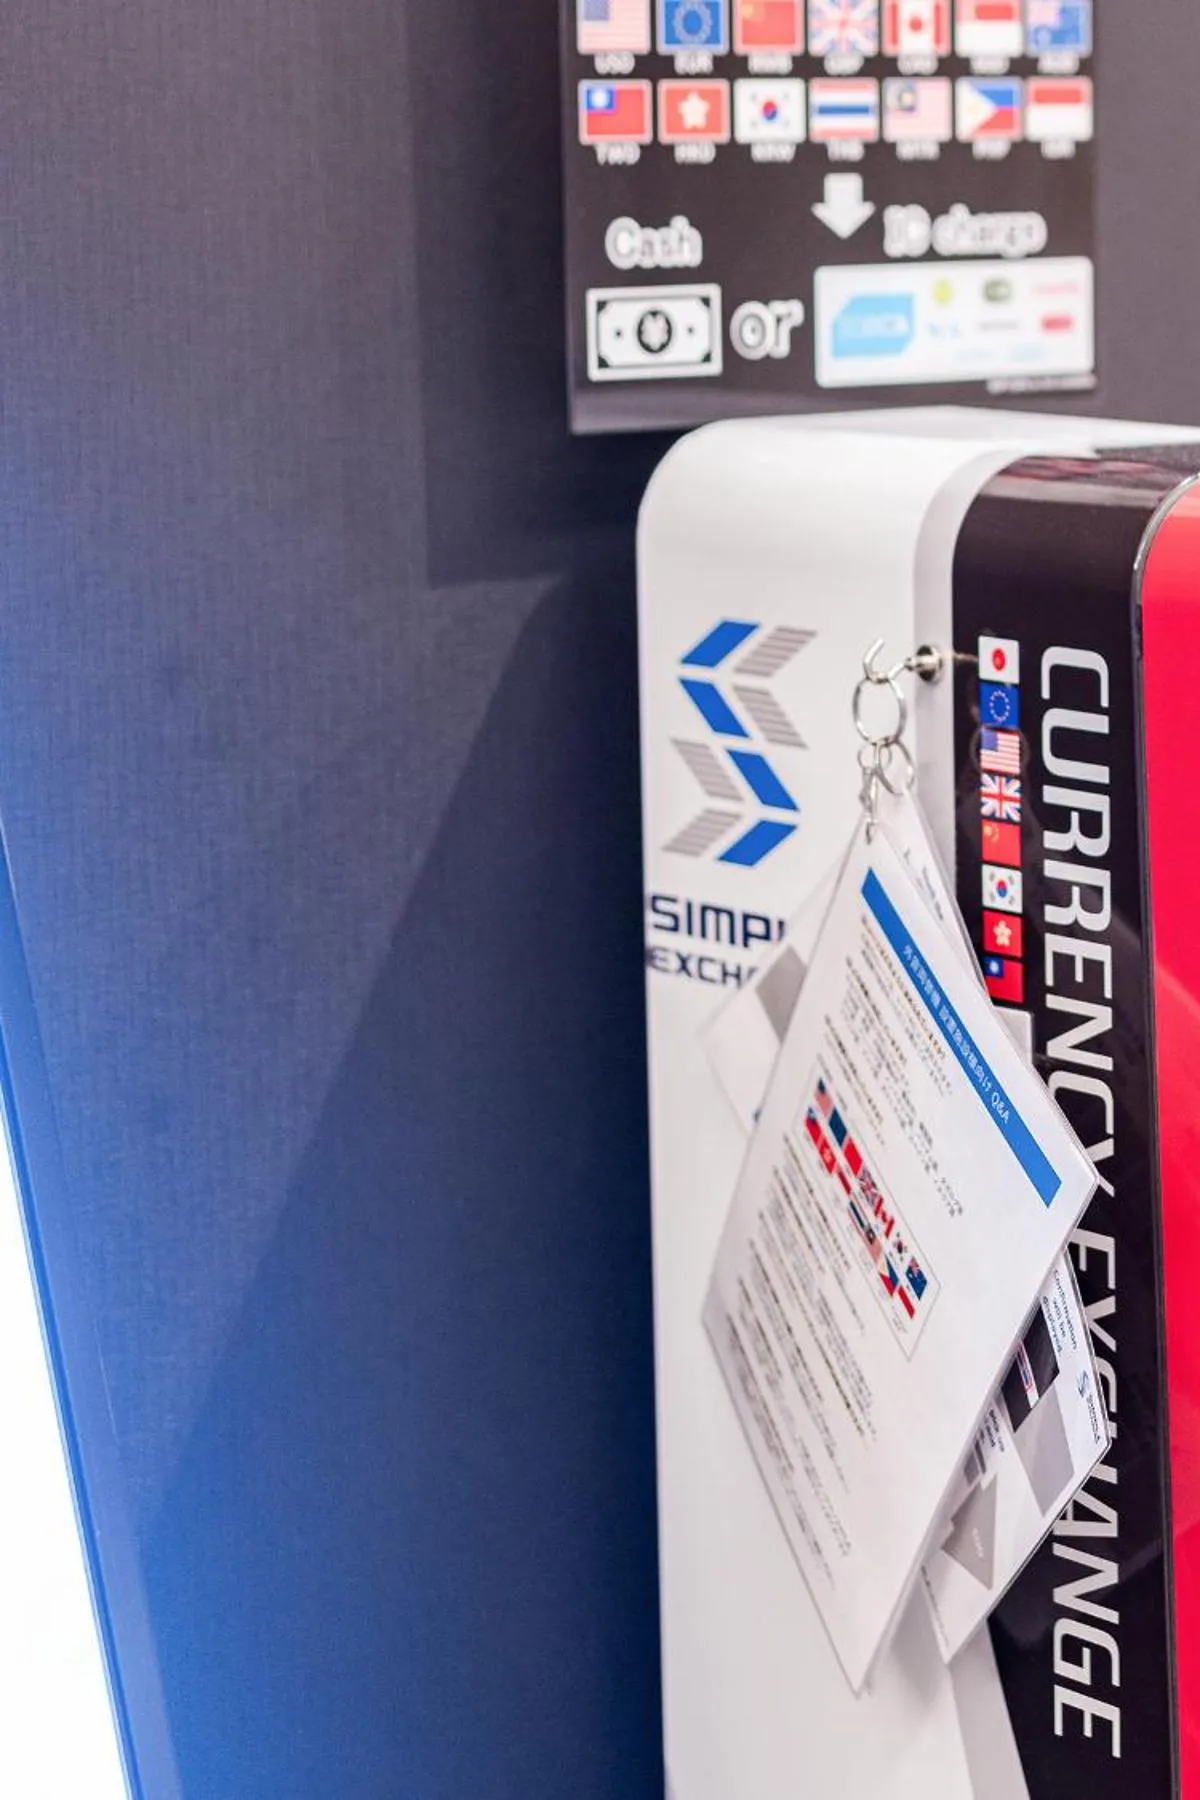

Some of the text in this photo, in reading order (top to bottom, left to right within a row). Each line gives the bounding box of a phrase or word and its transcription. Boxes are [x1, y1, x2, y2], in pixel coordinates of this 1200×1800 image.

[605, 215, 703, 269] Cash
[730, 299, 804, 360] or
[646, 945, 758, 988] EXCH
[1053, 1227, 1121, 1759] EANGE
